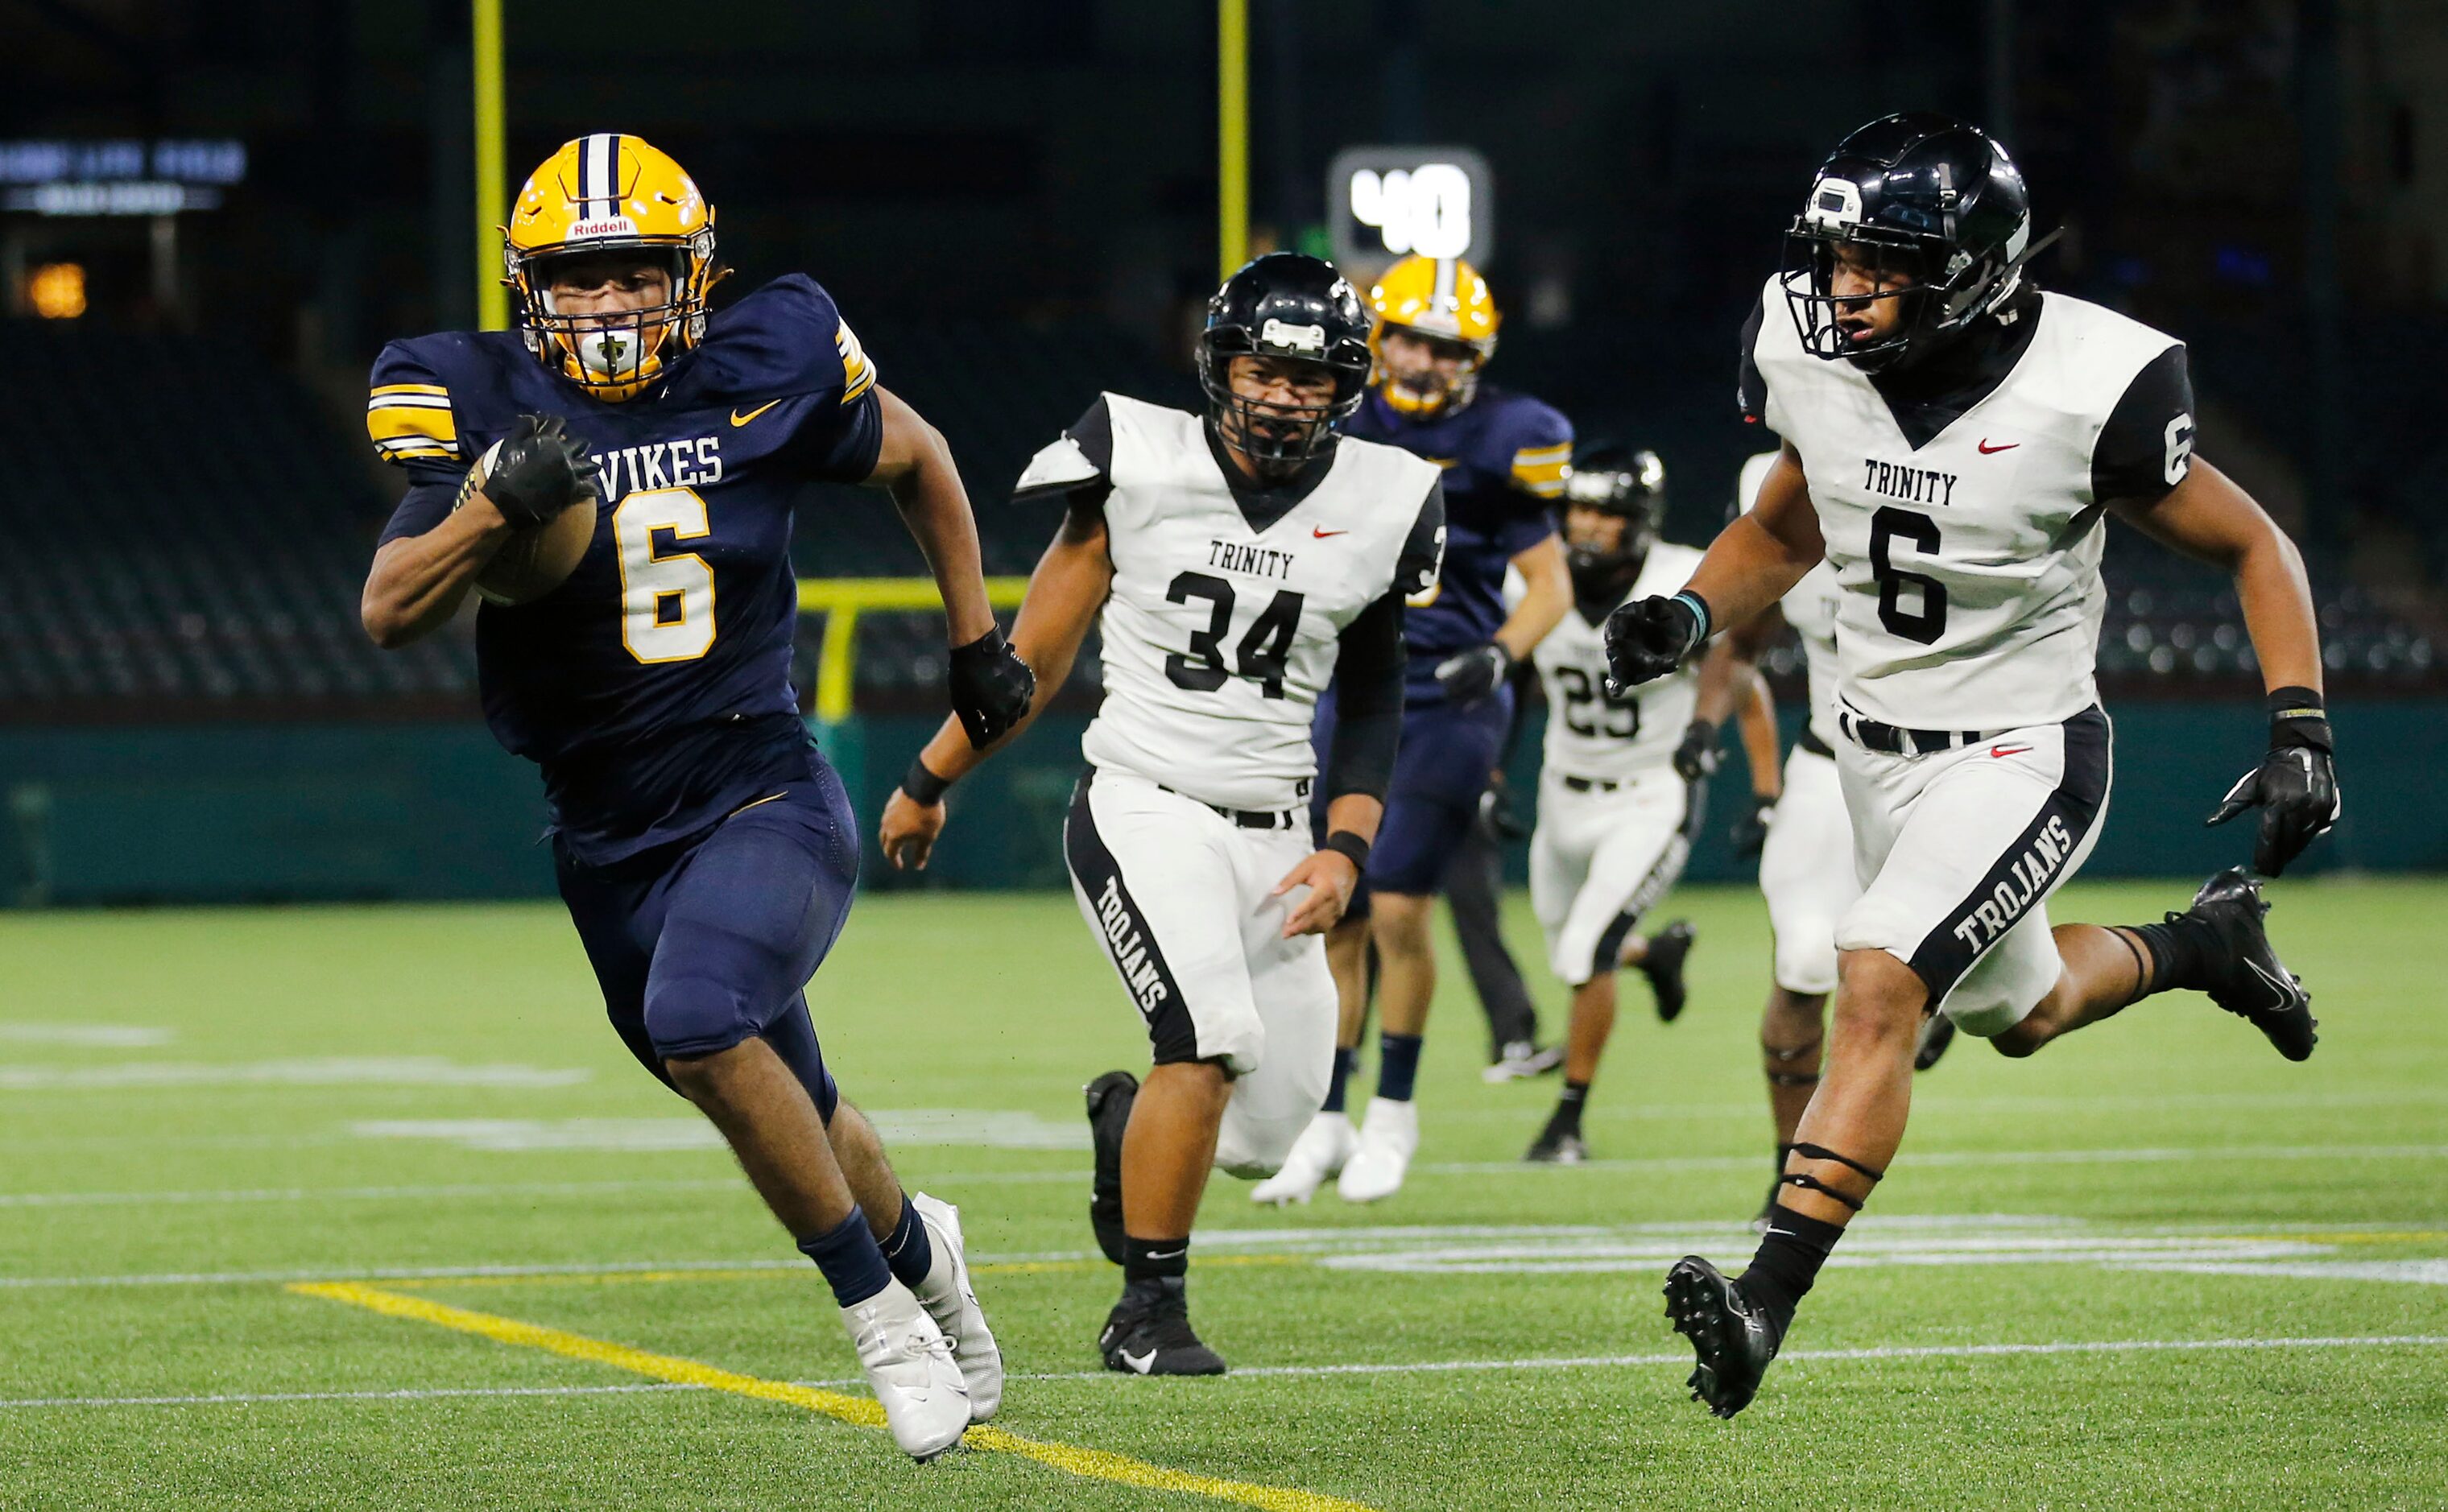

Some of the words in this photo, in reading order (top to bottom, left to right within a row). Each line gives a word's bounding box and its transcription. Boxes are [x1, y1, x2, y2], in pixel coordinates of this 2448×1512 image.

[574, 221, 628, 235] Riddell
[1350, 163, 1470, 258] 40
[590, 436, 722, 503] VIKES
[1864, 458, 1957, 506] TRINITY
[614, 487, 717, 664] 6
[1209, 540, 1295, 580] TRINITY
[1869, 505, 1947, 646] 6
[1164, 571, 1305, 700] 34
[1554, 666, 1640, 738] 25
[1953, 814, 2073, 955] TROJANS
[1096, 874, 1168, 1014] TROJANS
